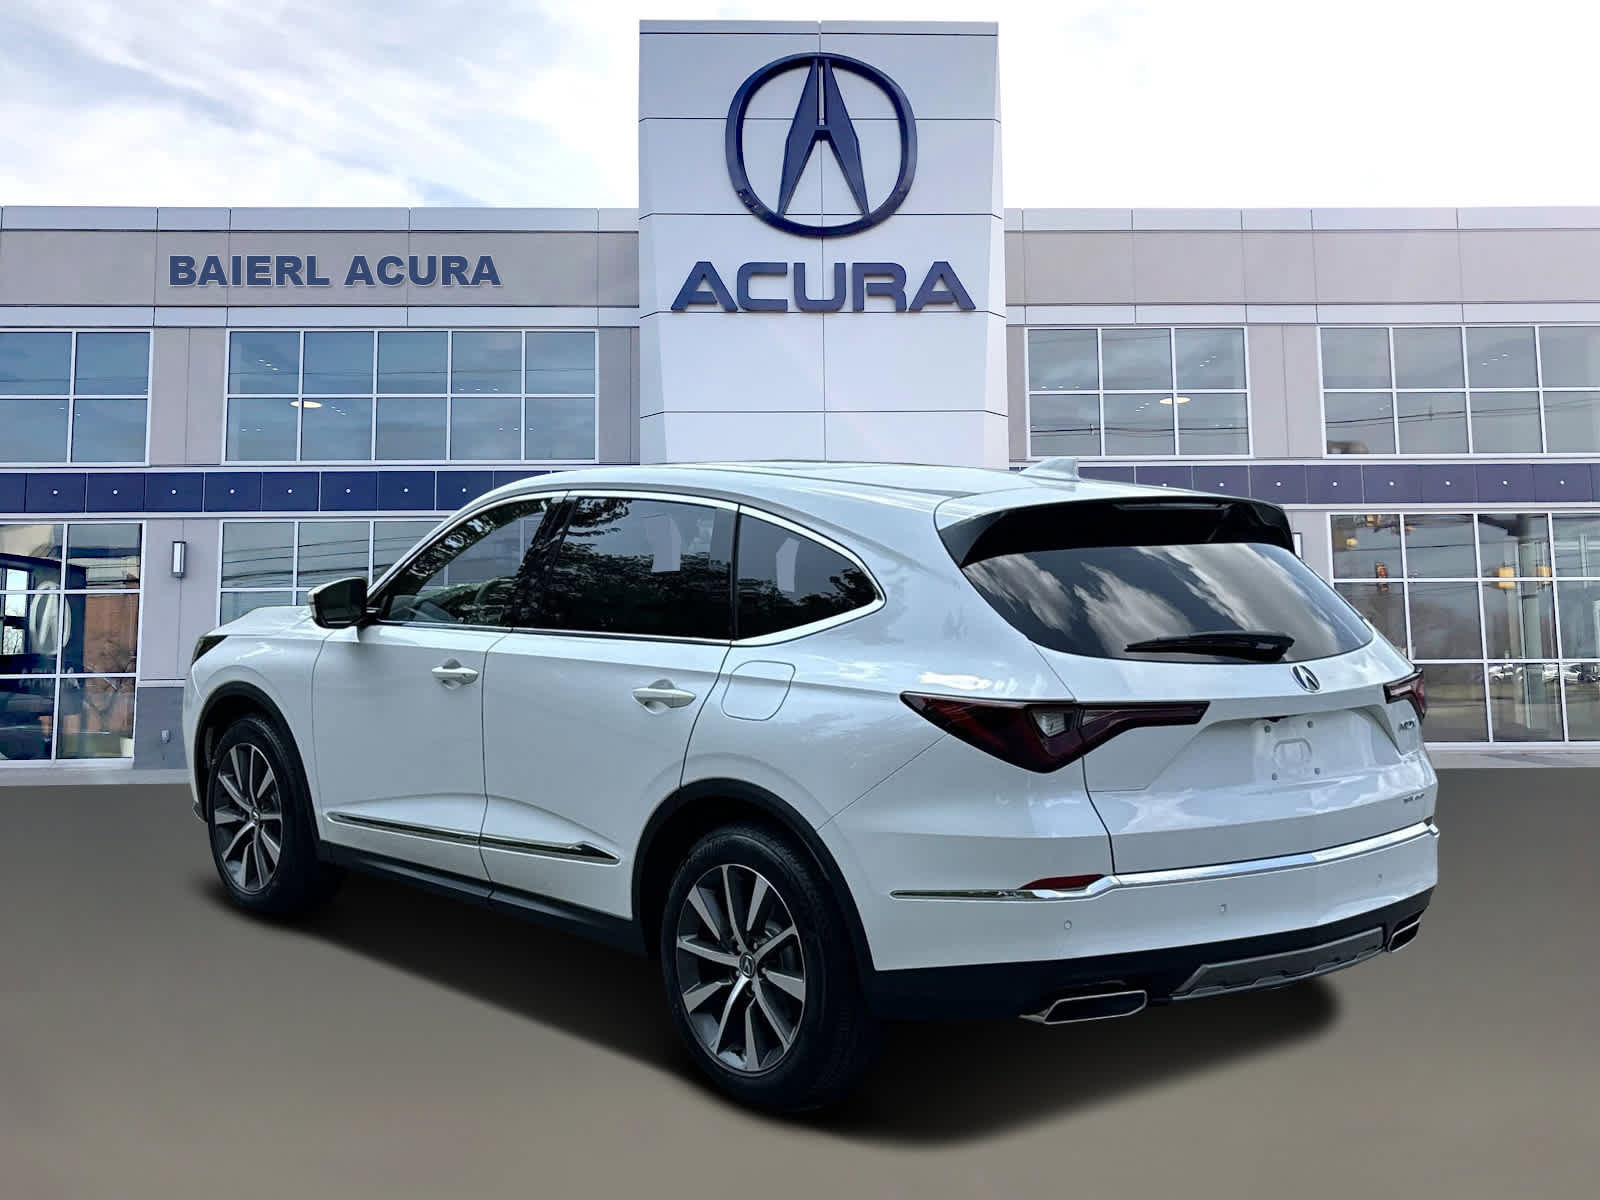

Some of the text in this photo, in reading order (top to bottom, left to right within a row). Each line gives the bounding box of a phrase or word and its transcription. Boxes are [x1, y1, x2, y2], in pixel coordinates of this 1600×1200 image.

[168, 255, 502, 287] BAIERL ACURA
[670, 260, 977, 313] ACURA
